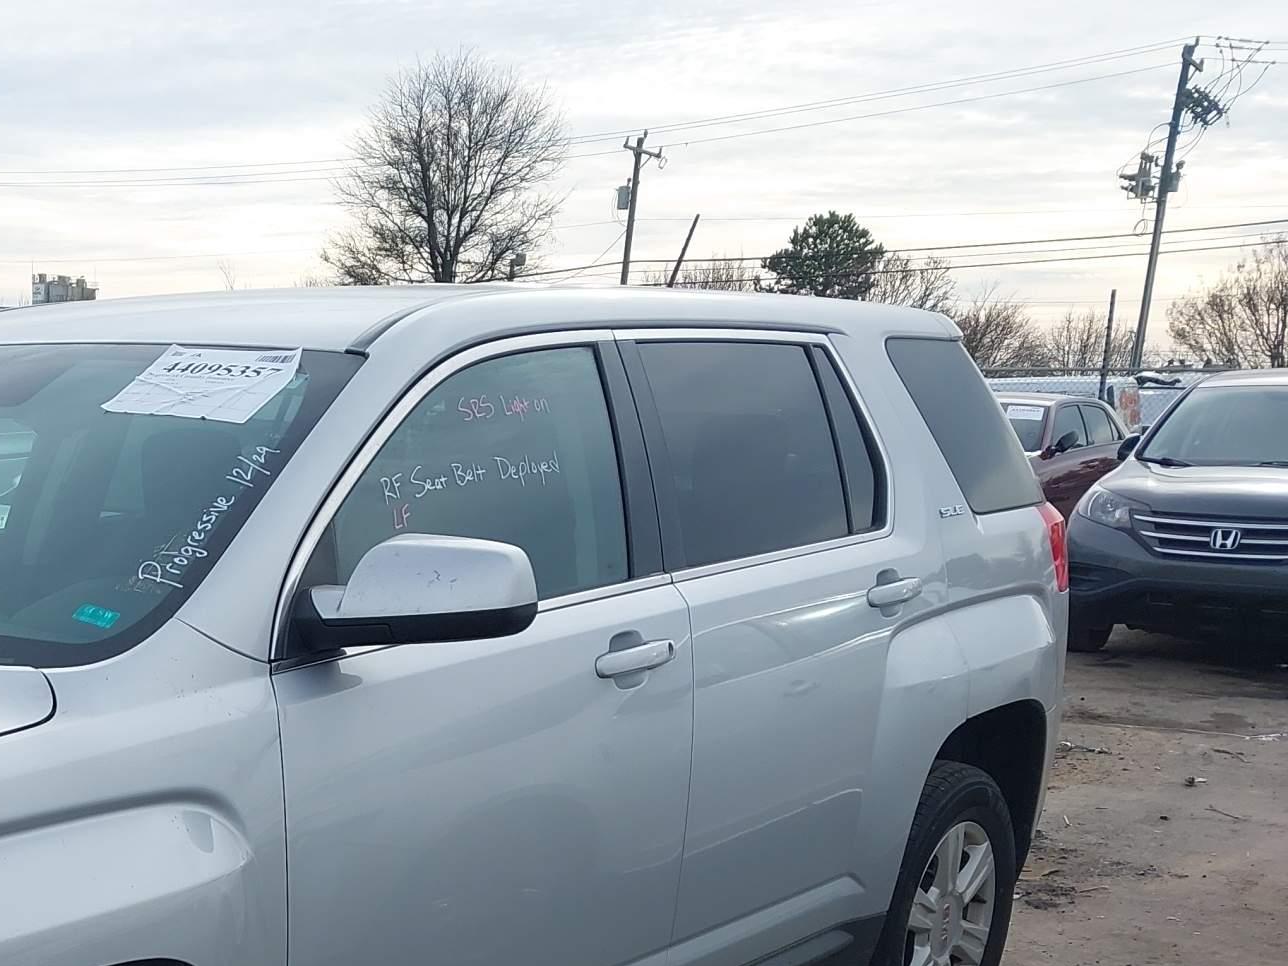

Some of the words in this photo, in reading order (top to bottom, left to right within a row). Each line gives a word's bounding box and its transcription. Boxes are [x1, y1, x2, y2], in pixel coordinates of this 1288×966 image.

[162, 361, 284, 378] 44095357
[533, 397, 551, 414] on
[380, 473, 403, 504] RF
[410, 465, 449, 498] Seat
[451, 462, 486, 487] Belt
[493, 451, 560, 487] Deployed
[138, 495, 235, 588] Progressive
[226, 446, 280, 487] 12/29
[393, 503, 411, 530] LF
